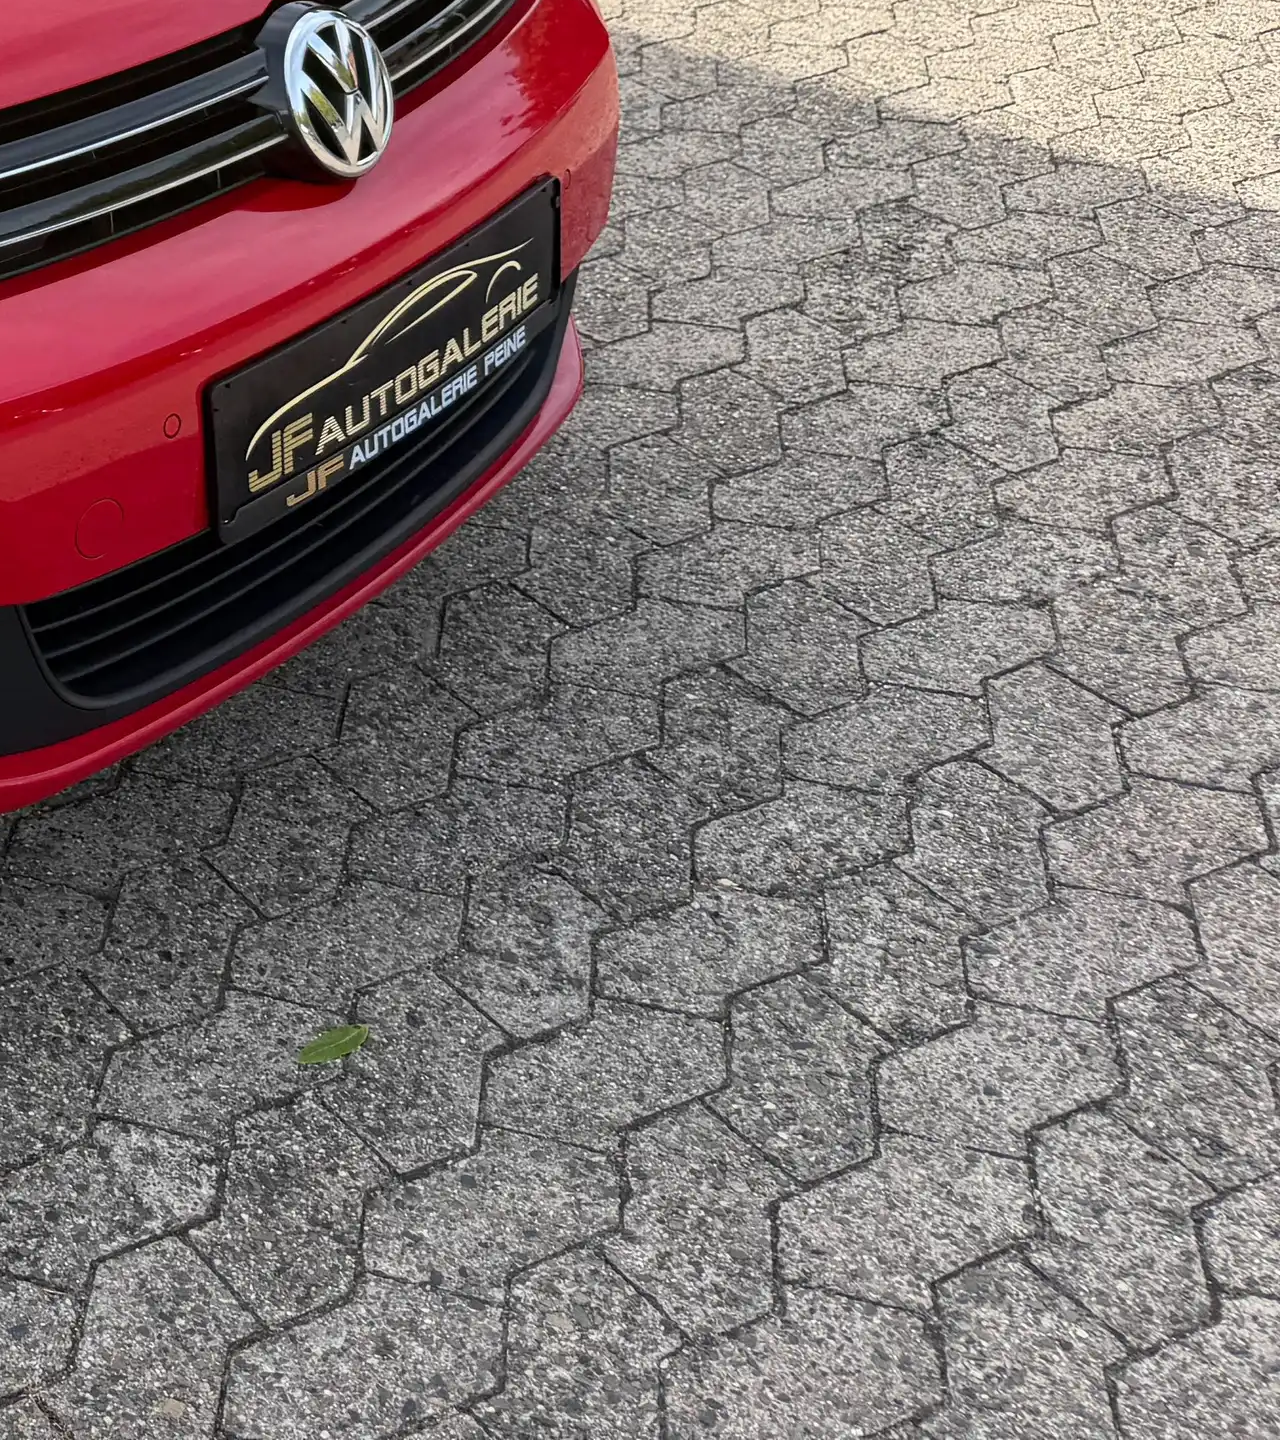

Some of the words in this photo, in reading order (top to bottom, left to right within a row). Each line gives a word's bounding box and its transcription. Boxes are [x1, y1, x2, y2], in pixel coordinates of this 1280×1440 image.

[248, 412, 313, 493] JF
[314, 272, 539, 456] AUTOGALERIE
[286, 454, 344, 507] JF
[349, 364, 477, 470] AUTOGALERIE
[484, 325, 526, 377] PEINE
